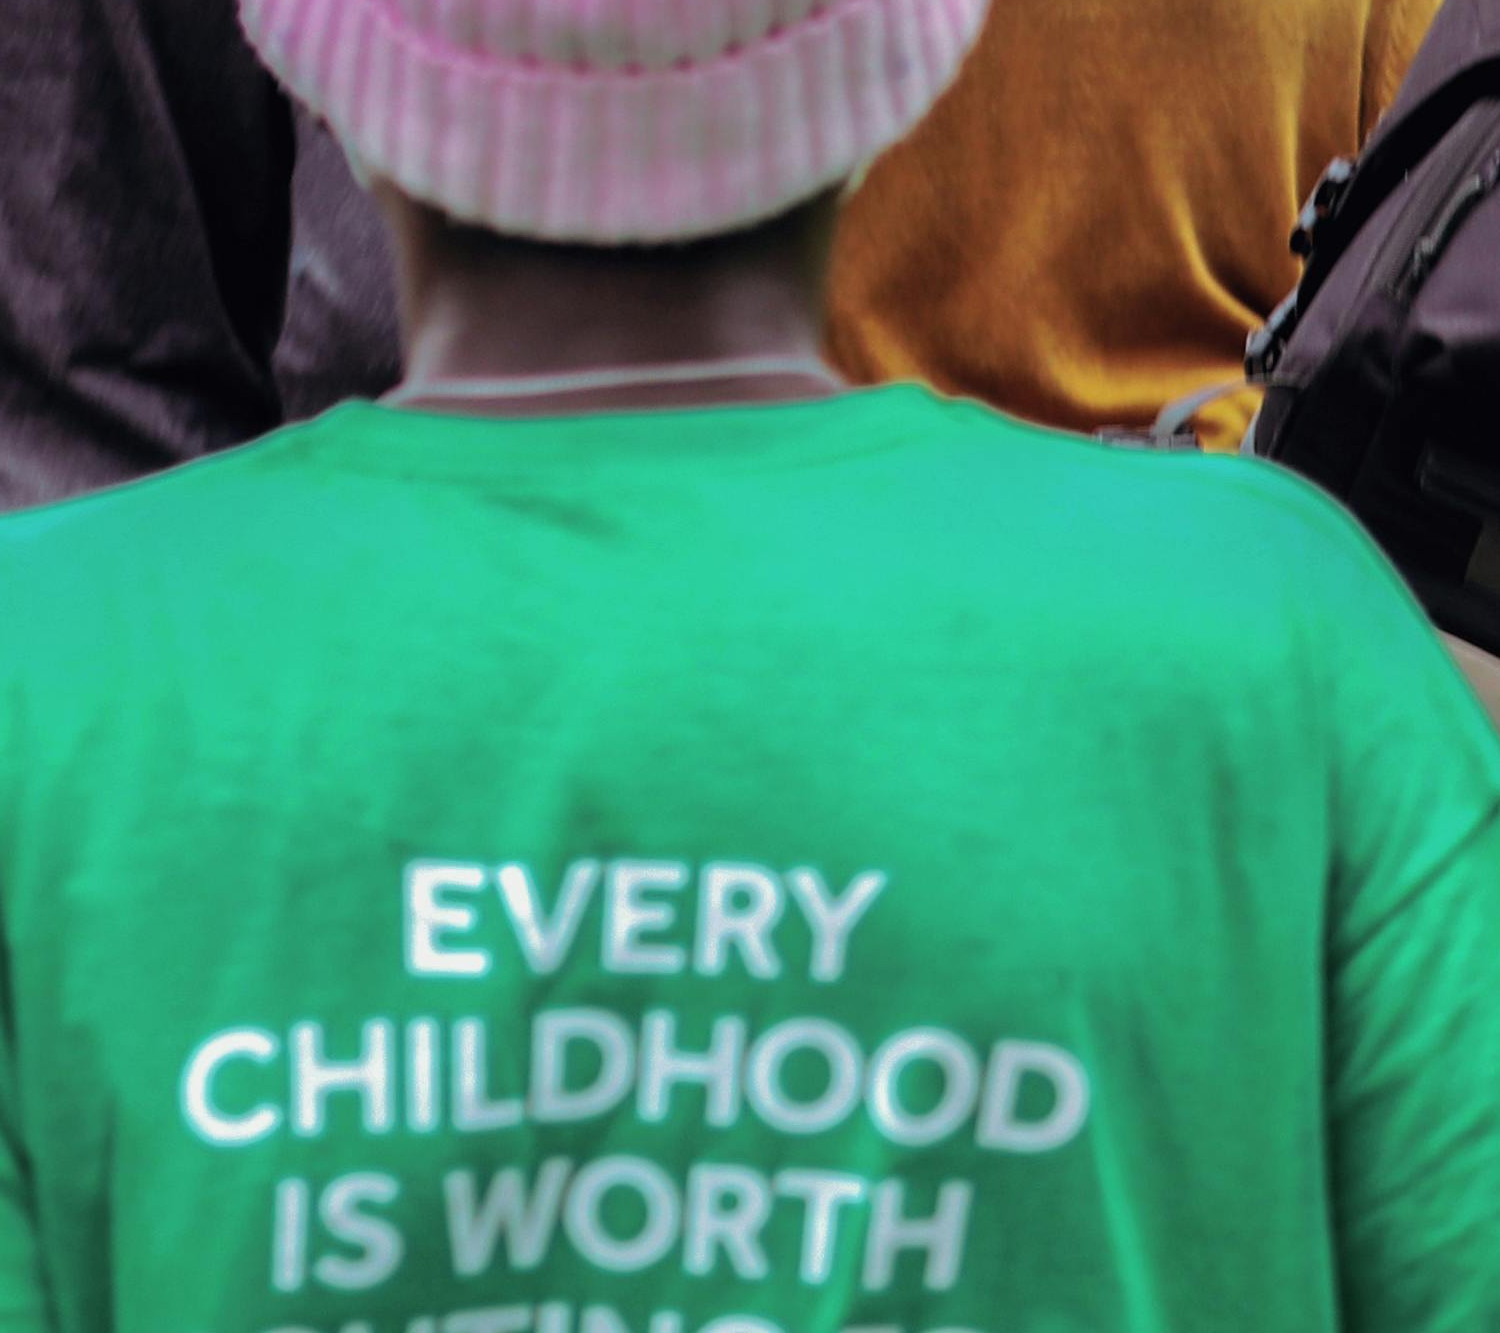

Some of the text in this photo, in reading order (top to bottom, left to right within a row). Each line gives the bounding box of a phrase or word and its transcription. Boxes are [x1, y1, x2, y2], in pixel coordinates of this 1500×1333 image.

[402, 857, 888, 982] EVERY
[179, 1007, 1091, 1153] CHILDHOOD
[271, 1155, 973, 1293] IS WORTH
